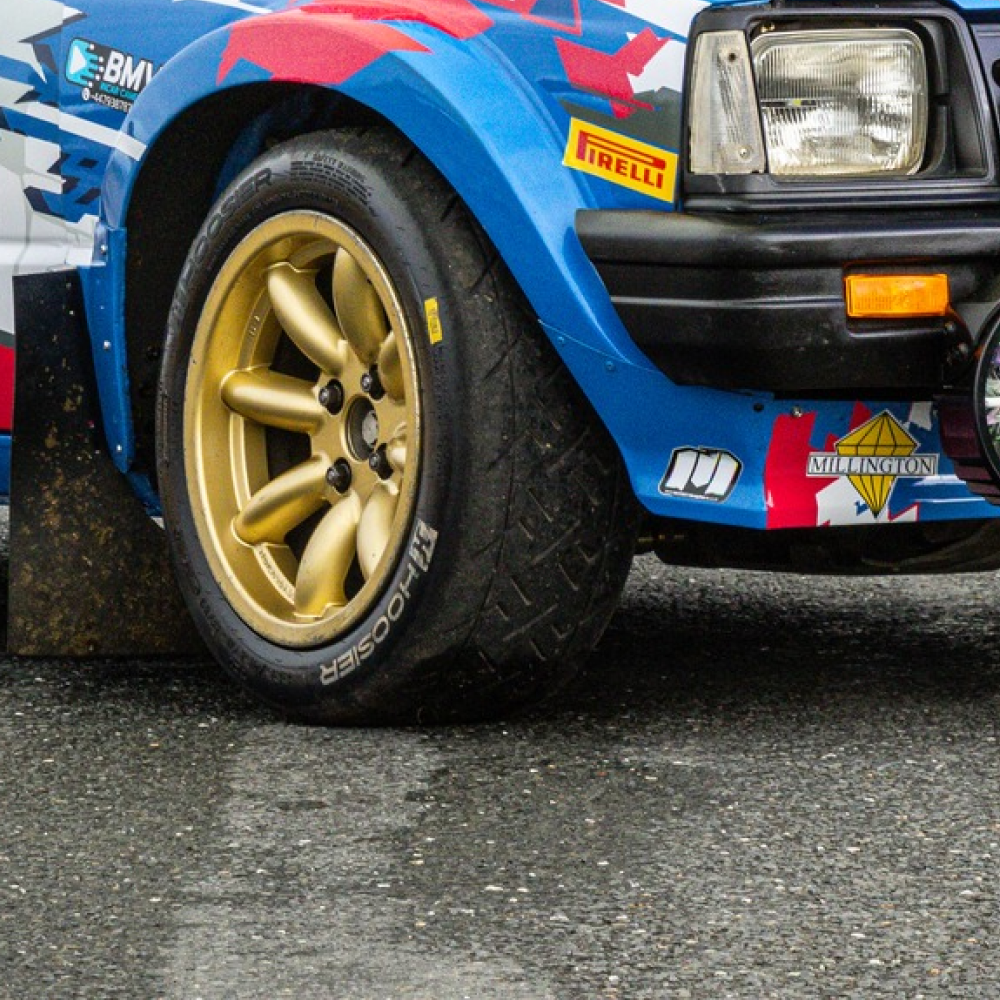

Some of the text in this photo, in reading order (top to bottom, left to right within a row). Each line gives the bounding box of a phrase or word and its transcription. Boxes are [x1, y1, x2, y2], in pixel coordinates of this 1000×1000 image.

[575, 128, 667, 190] PIRELLI
[808, 457, 934, 475] MILLINGTON
[319, 562, 420, 687] HOOSIER
